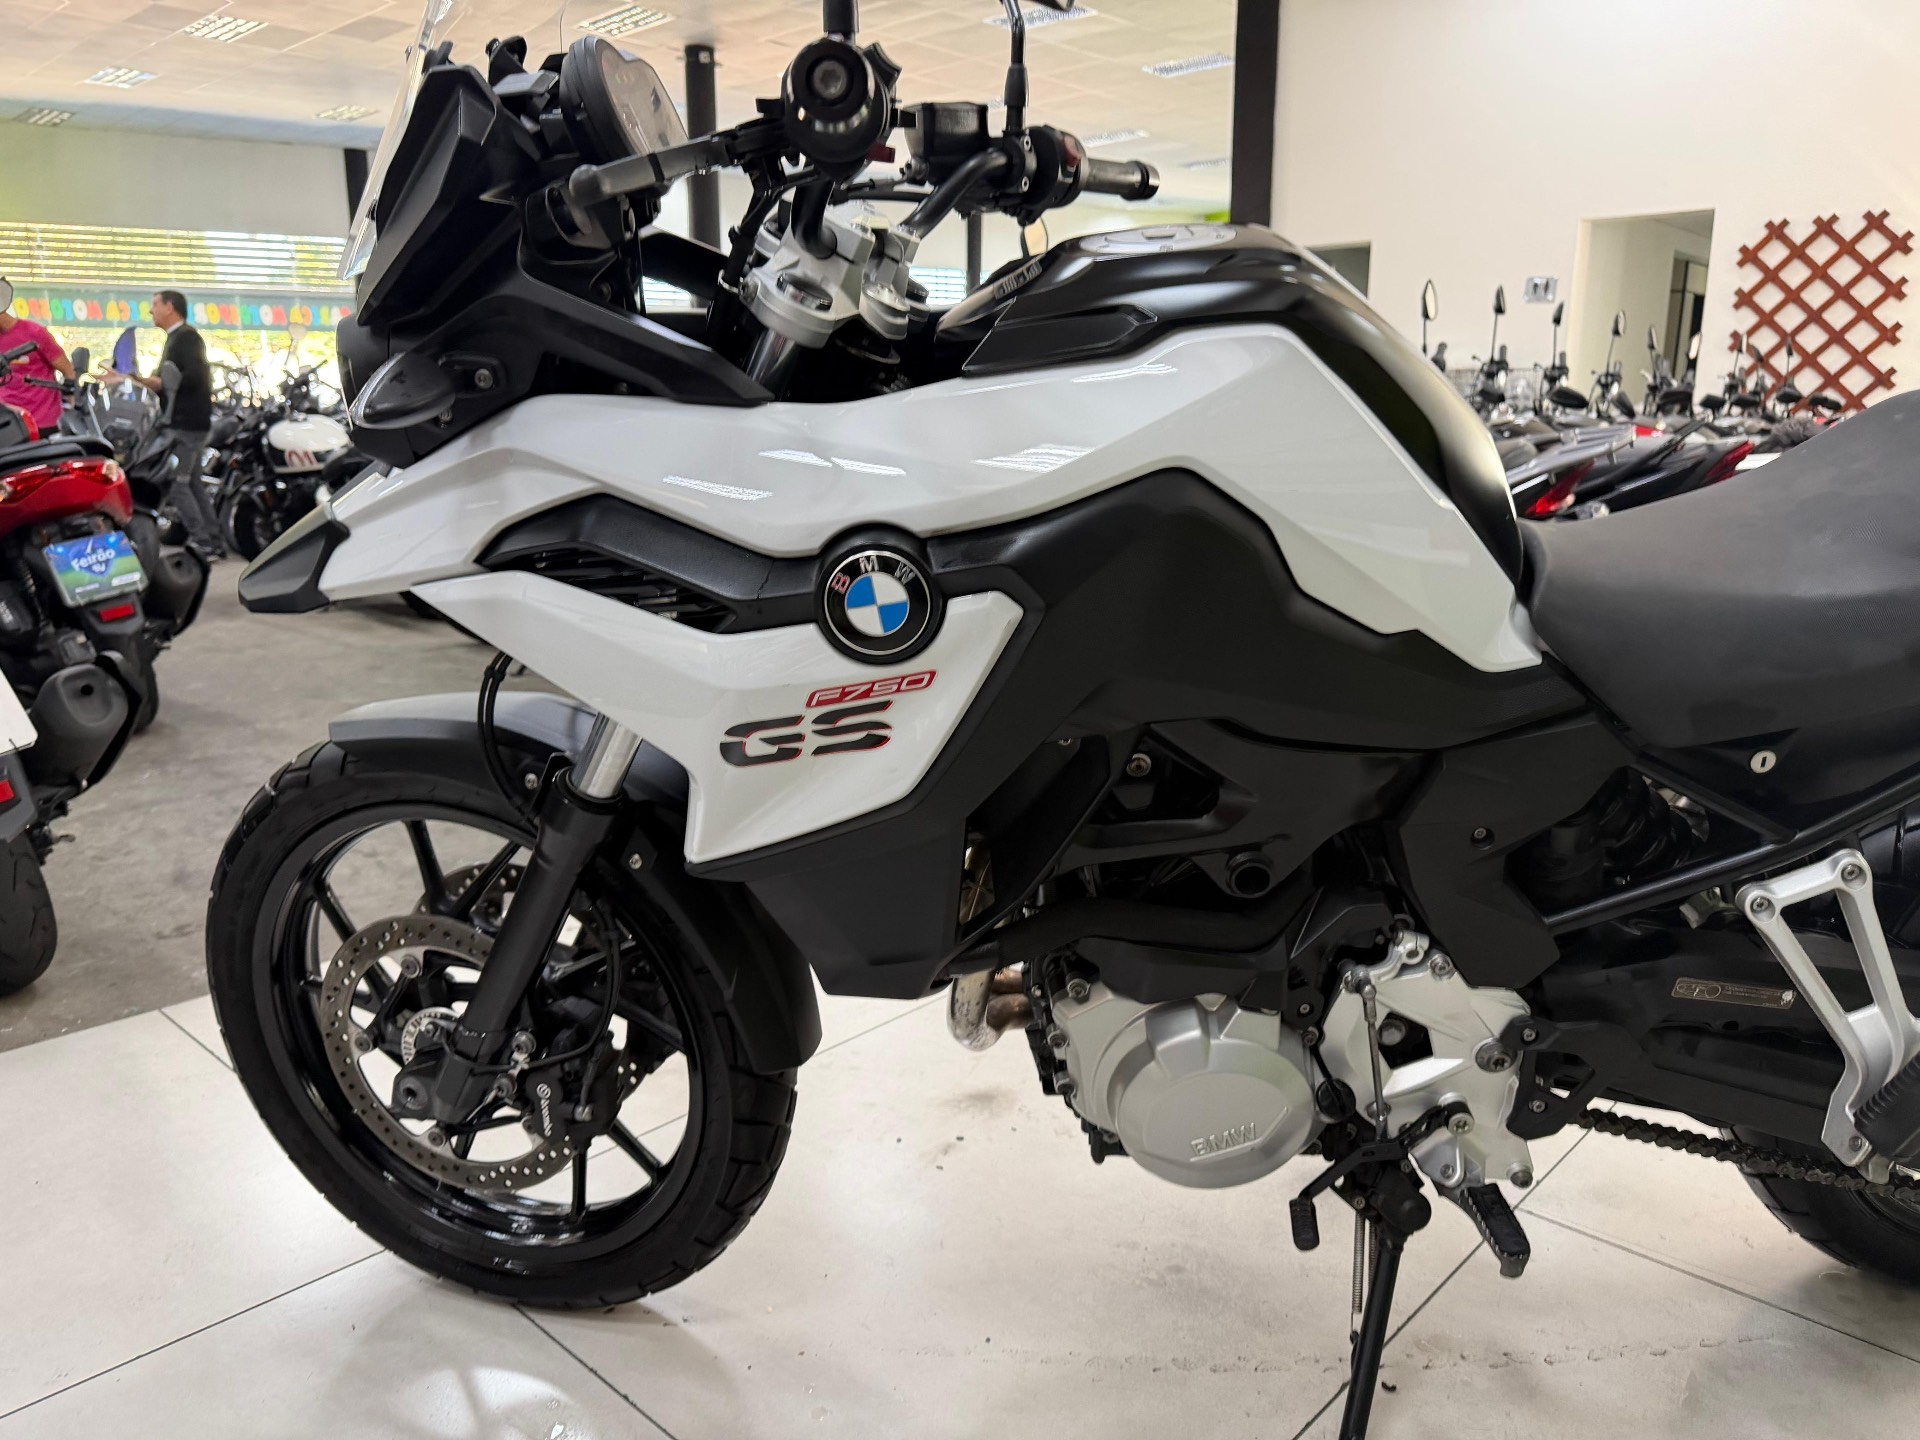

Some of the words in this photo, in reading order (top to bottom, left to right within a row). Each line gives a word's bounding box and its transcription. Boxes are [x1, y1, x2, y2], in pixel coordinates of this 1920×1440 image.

[71, 547, 116, 572] Feirão
[831, 554, 916, 595] BMW
[810, 672, 932, 707] F750
[720, 700, 892, 767] GS
[1191, 1122, 1256, 1155] BMW
